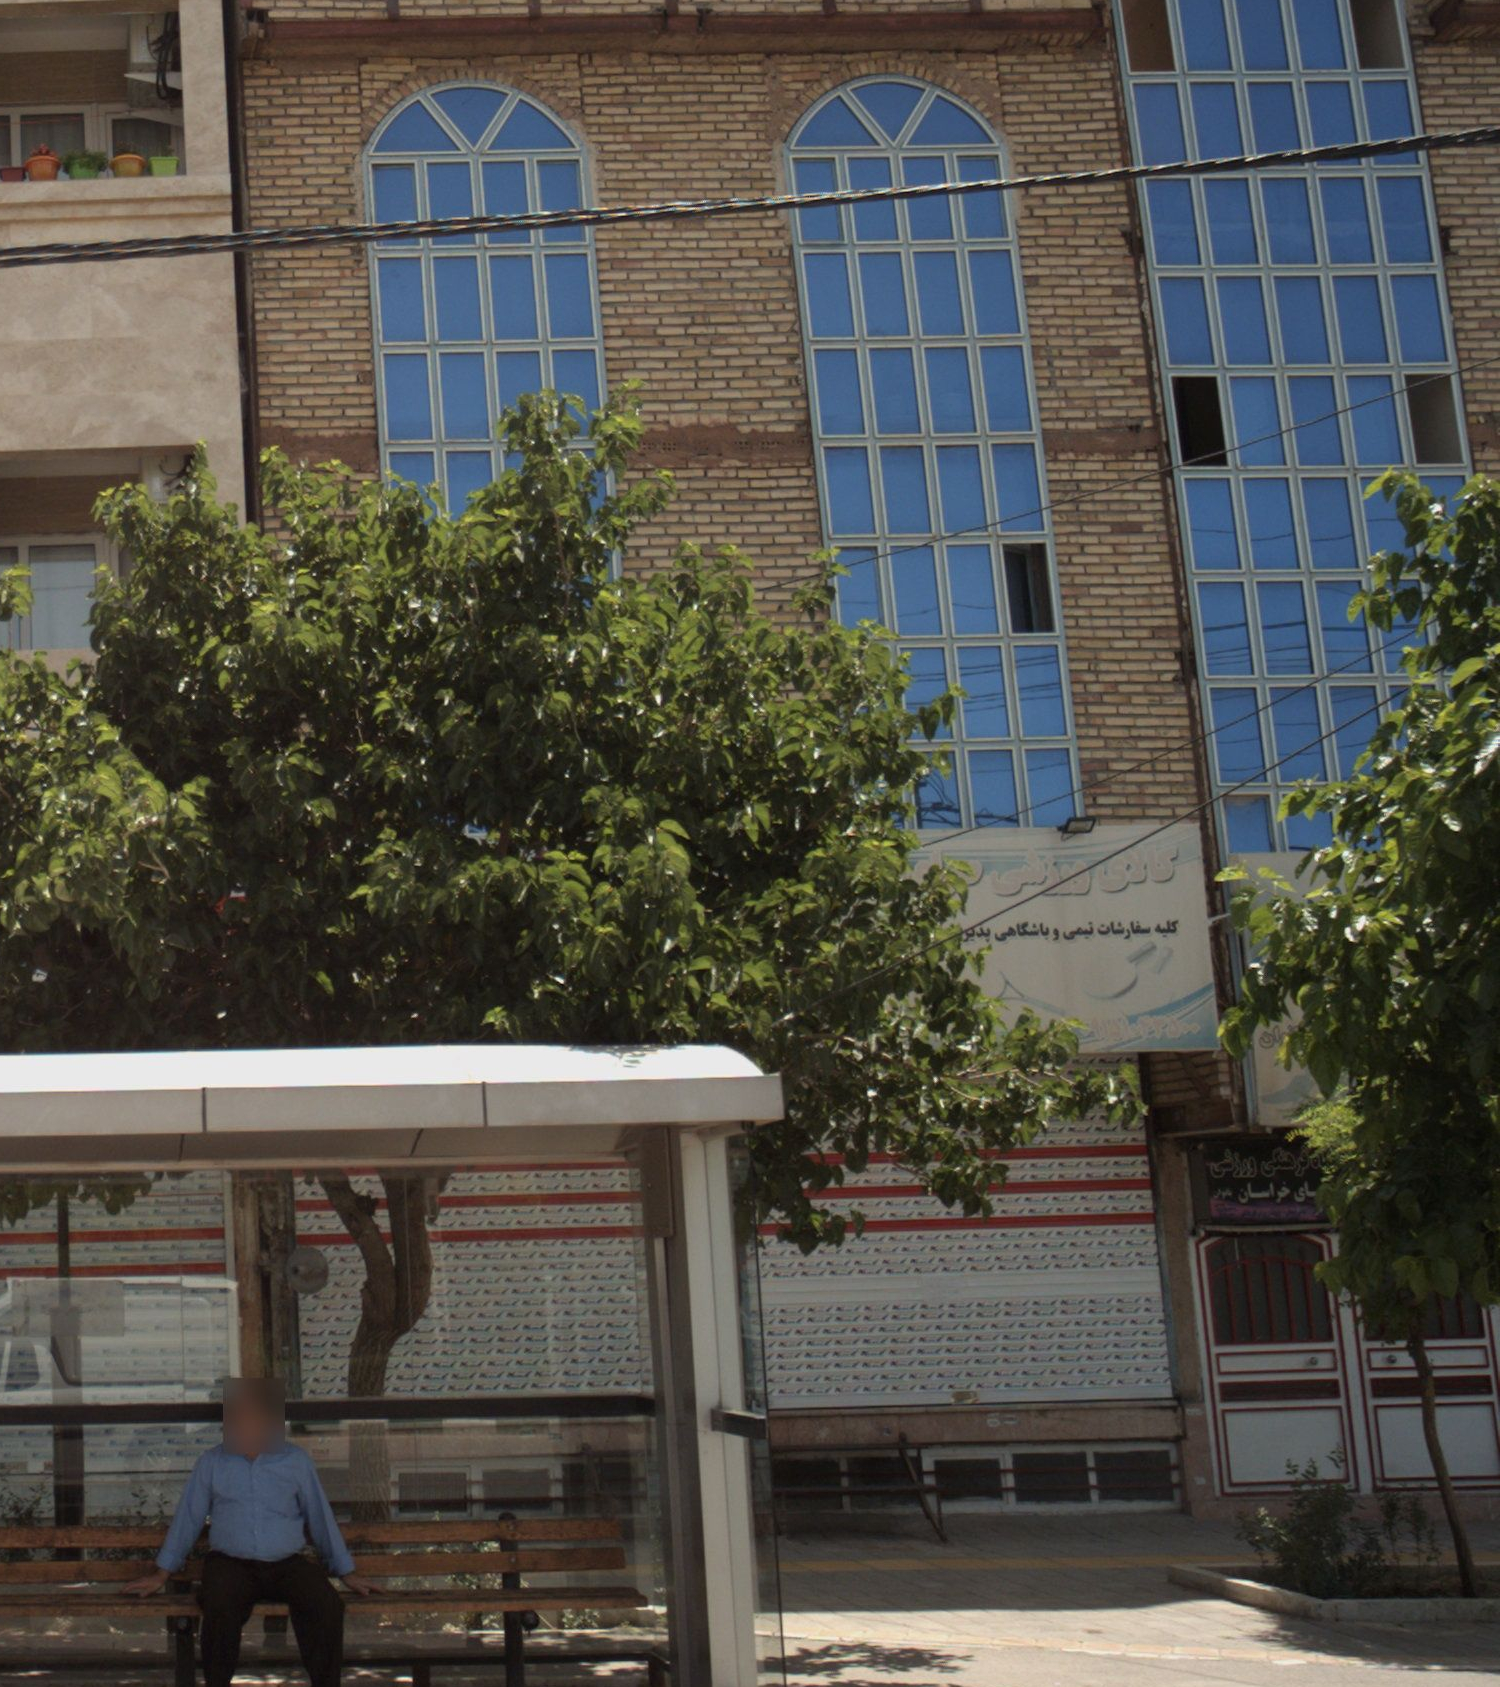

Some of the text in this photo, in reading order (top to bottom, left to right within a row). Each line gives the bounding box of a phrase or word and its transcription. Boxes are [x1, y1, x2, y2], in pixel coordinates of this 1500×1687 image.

[994, 921, 1050, 942] باشگاهی
[1052, 927, 1059, 941] و
[1062, 921, 1094, 941] تیمی
[1097, 919, 1151, 940] سفارشات
[1155, 919, 1179, 940] کلیه
[1238, 1180, 1291, 1204] خراسان
